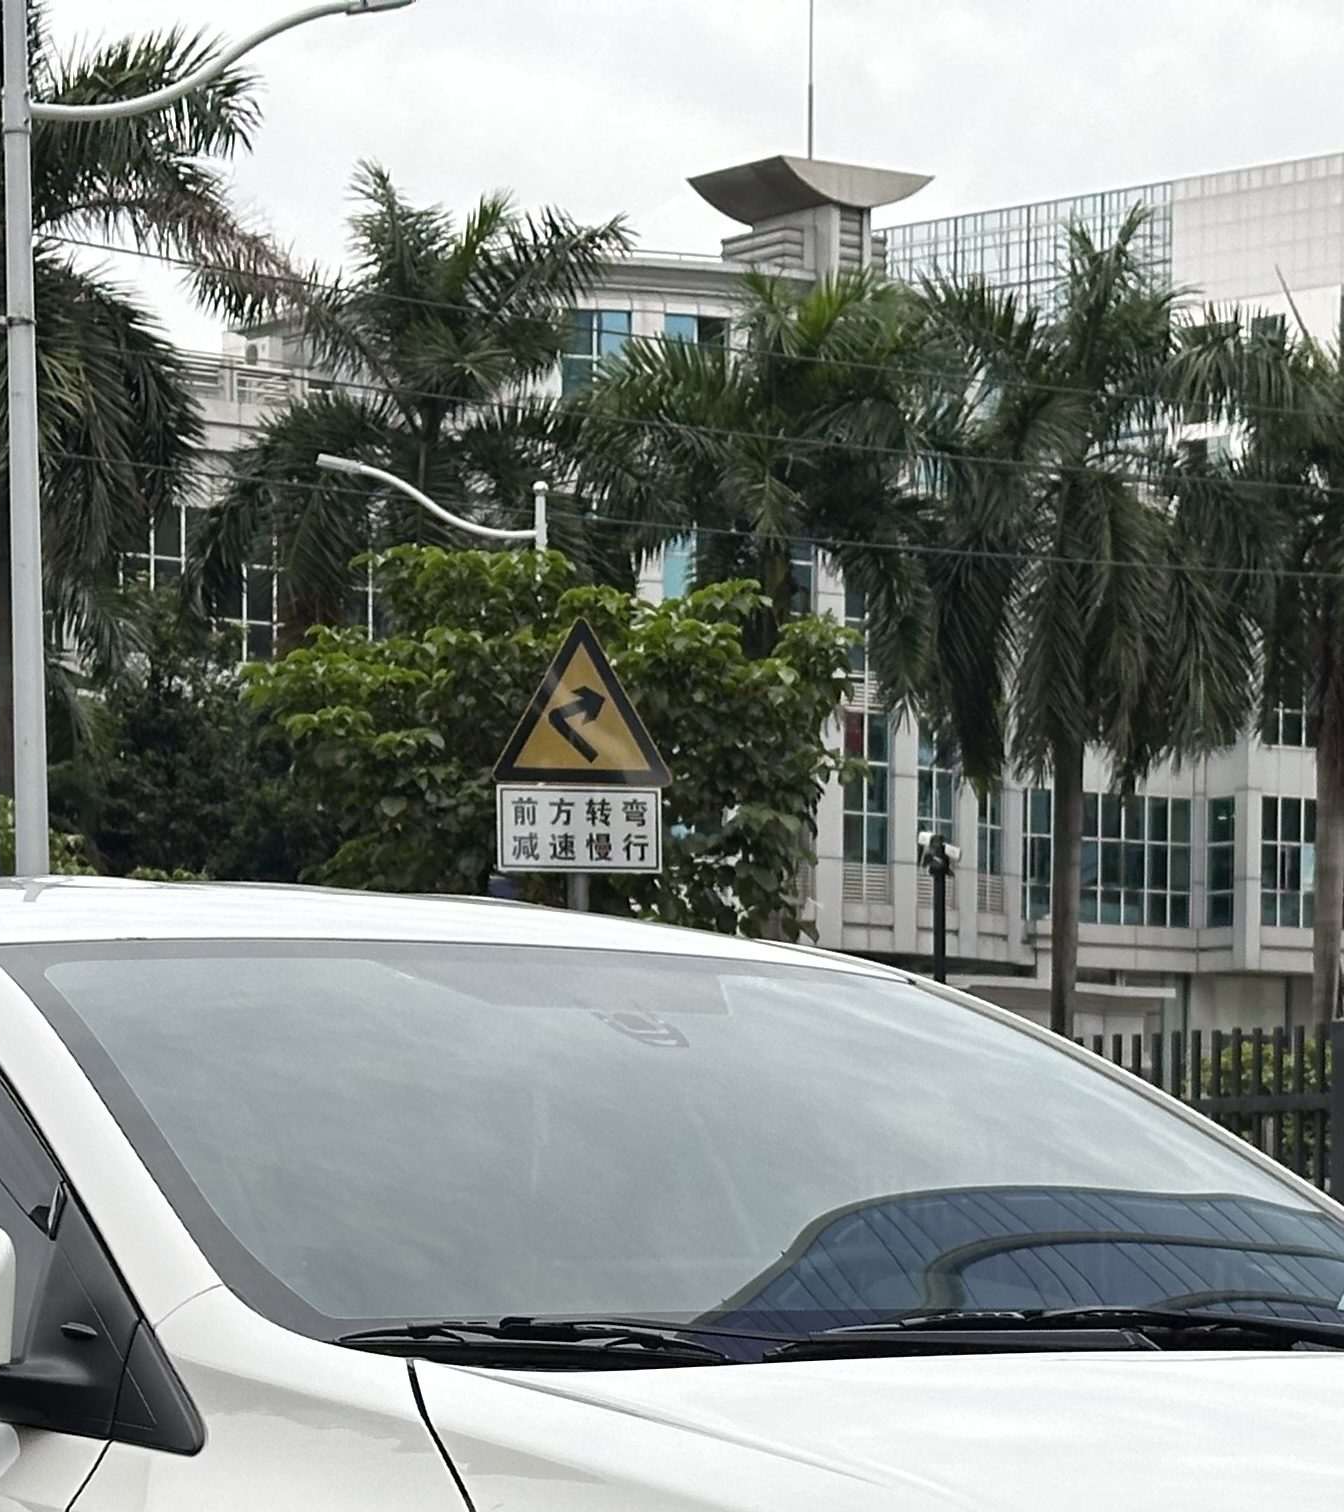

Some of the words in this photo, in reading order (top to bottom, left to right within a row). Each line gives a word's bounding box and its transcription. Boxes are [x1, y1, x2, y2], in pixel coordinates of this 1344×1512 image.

[512, 797, 648, 827] 前方转弯
[511, 832, 649, 862] 减速慢行
